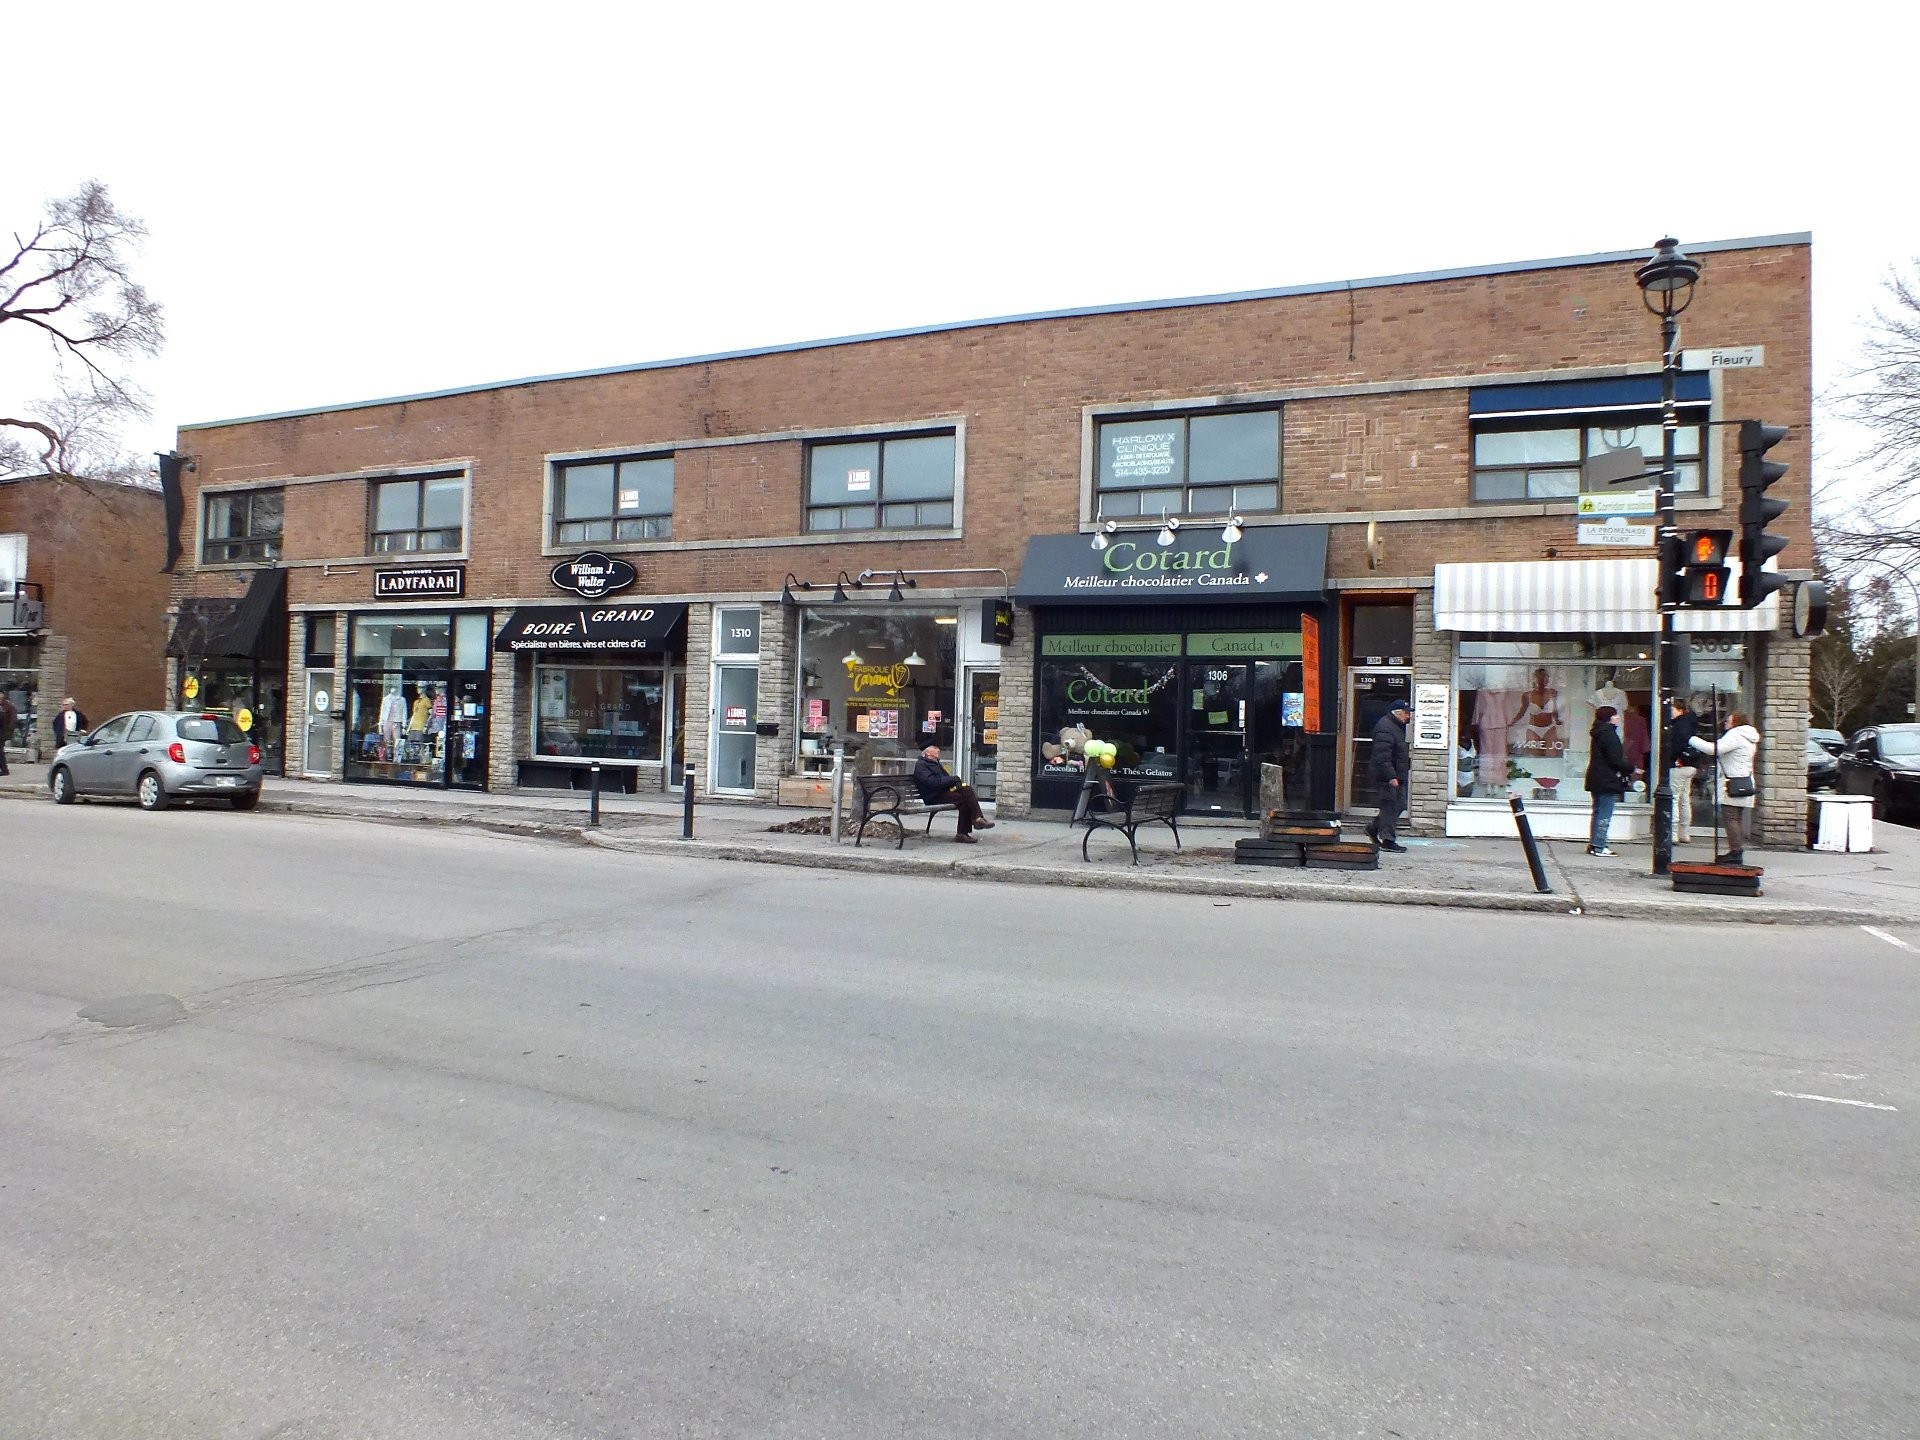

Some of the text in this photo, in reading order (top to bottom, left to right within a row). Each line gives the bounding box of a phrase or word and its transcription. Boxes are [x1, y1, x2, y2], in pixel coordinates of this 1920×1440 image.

[1712, 355, 1753, 366] Fleury
[1112, 434, 1164, 445] HARLOW
[1116, 442, 1171, 454] CLINIQUE
[1598, 527, 1647, 535] PROMENADE
[1103, 541, 1233, 572] Cotard
[570, 563, 616, 575] William J.
[381, 575, 454, 590] LADYFARAH
[578, 575, 606, 587] Walter
[1064, 572, 1250, 588] Meilleur chocolatier Canada
[522, 623, 576, 635] BOIRE
[591, 609, 655, 622] GRAND
[730, 628, 751, 638] 1310
[510, 640, 547, 650] Spécialiste
[582, 640, 597, 648] vins
[606, 639, 629, 648] cidres
[1048, 638, 1176, 653] Meilleur chocolatier
[1211, 637, 1264, 651] Canada
[854, 665, 889, 673] FABRIQUE
[1208, 670, 1228, 681] 1306
[1067, 679, 1150, 704] Cotard
[569, 703, 631, 717] BOIRE GRAND
[1120, 708, 1142, 716] Canada
[1513, 739, 1563, 751] MARIE JO
[1044, 764, 1078, 773] Chocolats
[1122, 767, 1140, 775] Thés
[1145, 768, 1173, 777] Gelatos
